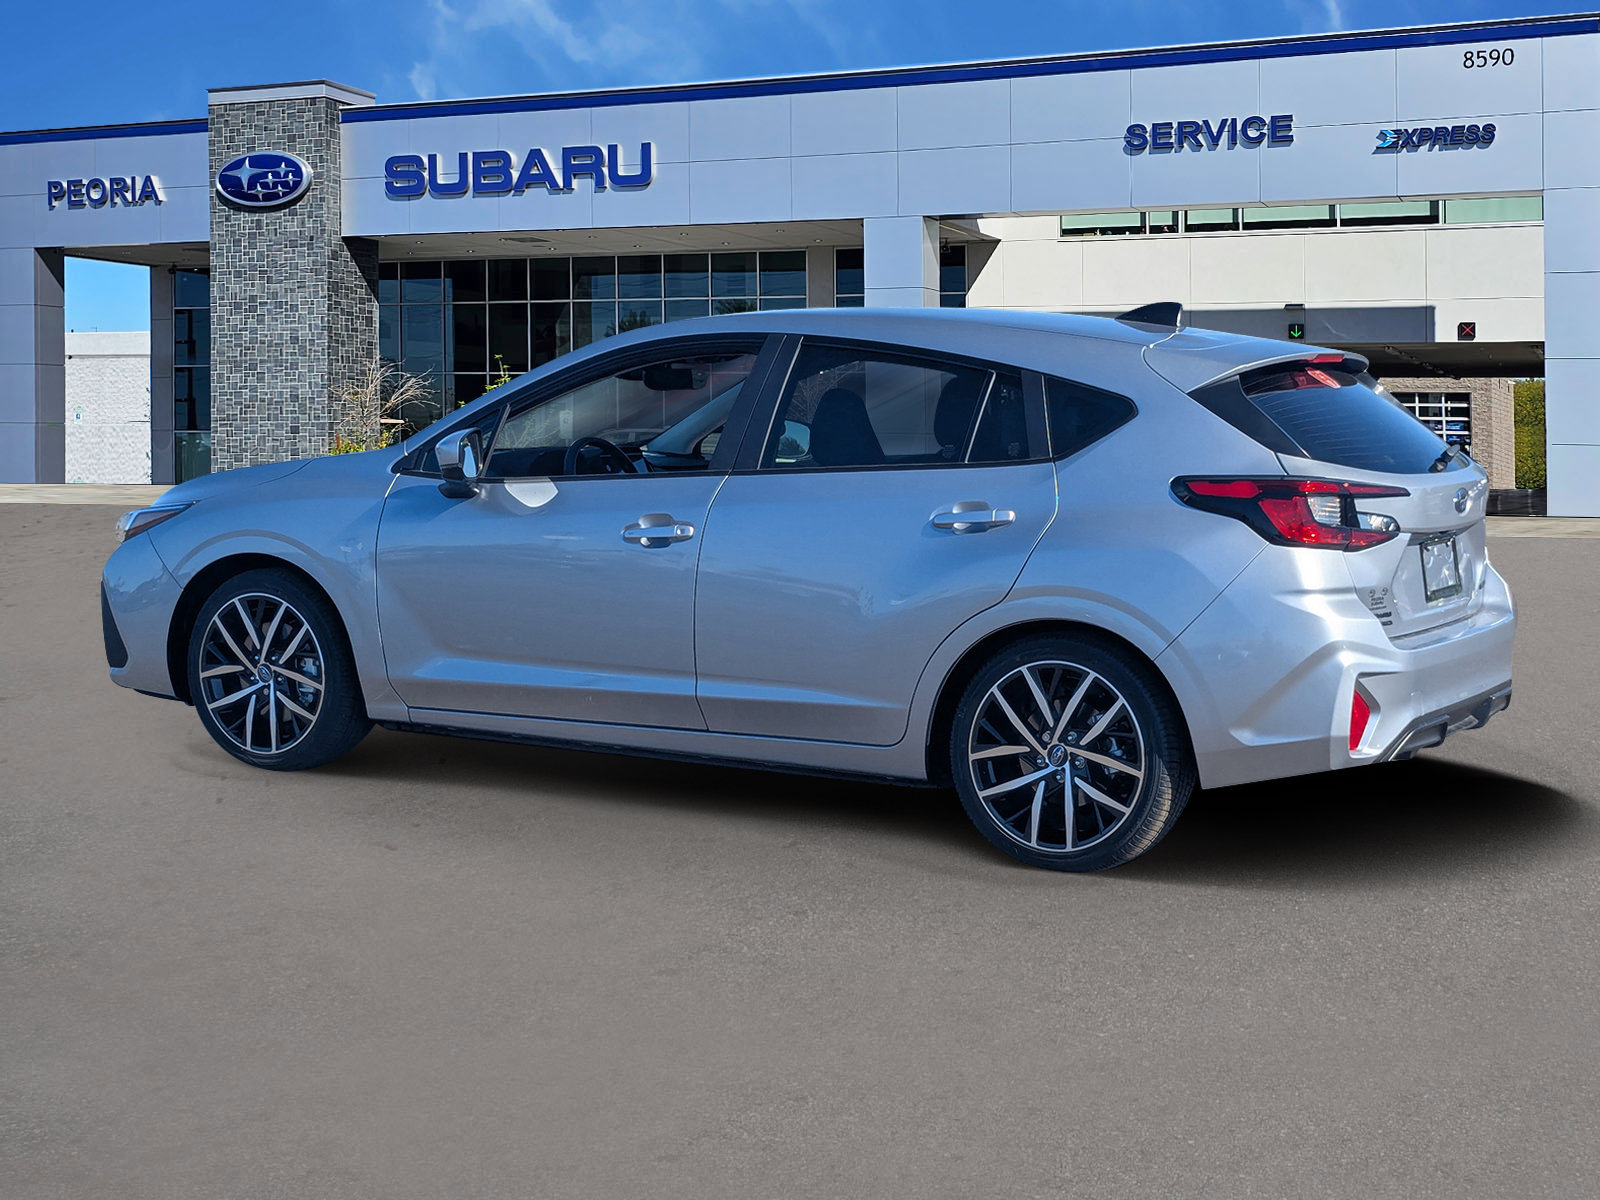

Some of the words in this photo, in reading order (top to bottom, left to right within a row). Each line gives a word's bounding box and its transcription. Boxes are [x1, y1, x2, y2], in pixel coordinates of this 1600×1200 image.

[1463, 48, 1514, 69] 8590
[1124, 114, 1294, 152] SERVICE
[1375, 123, 1497, 149] EXPRESS
[384, 142, 652, 197] SUBARU
[47, 175, 162, 209] PEORIA
